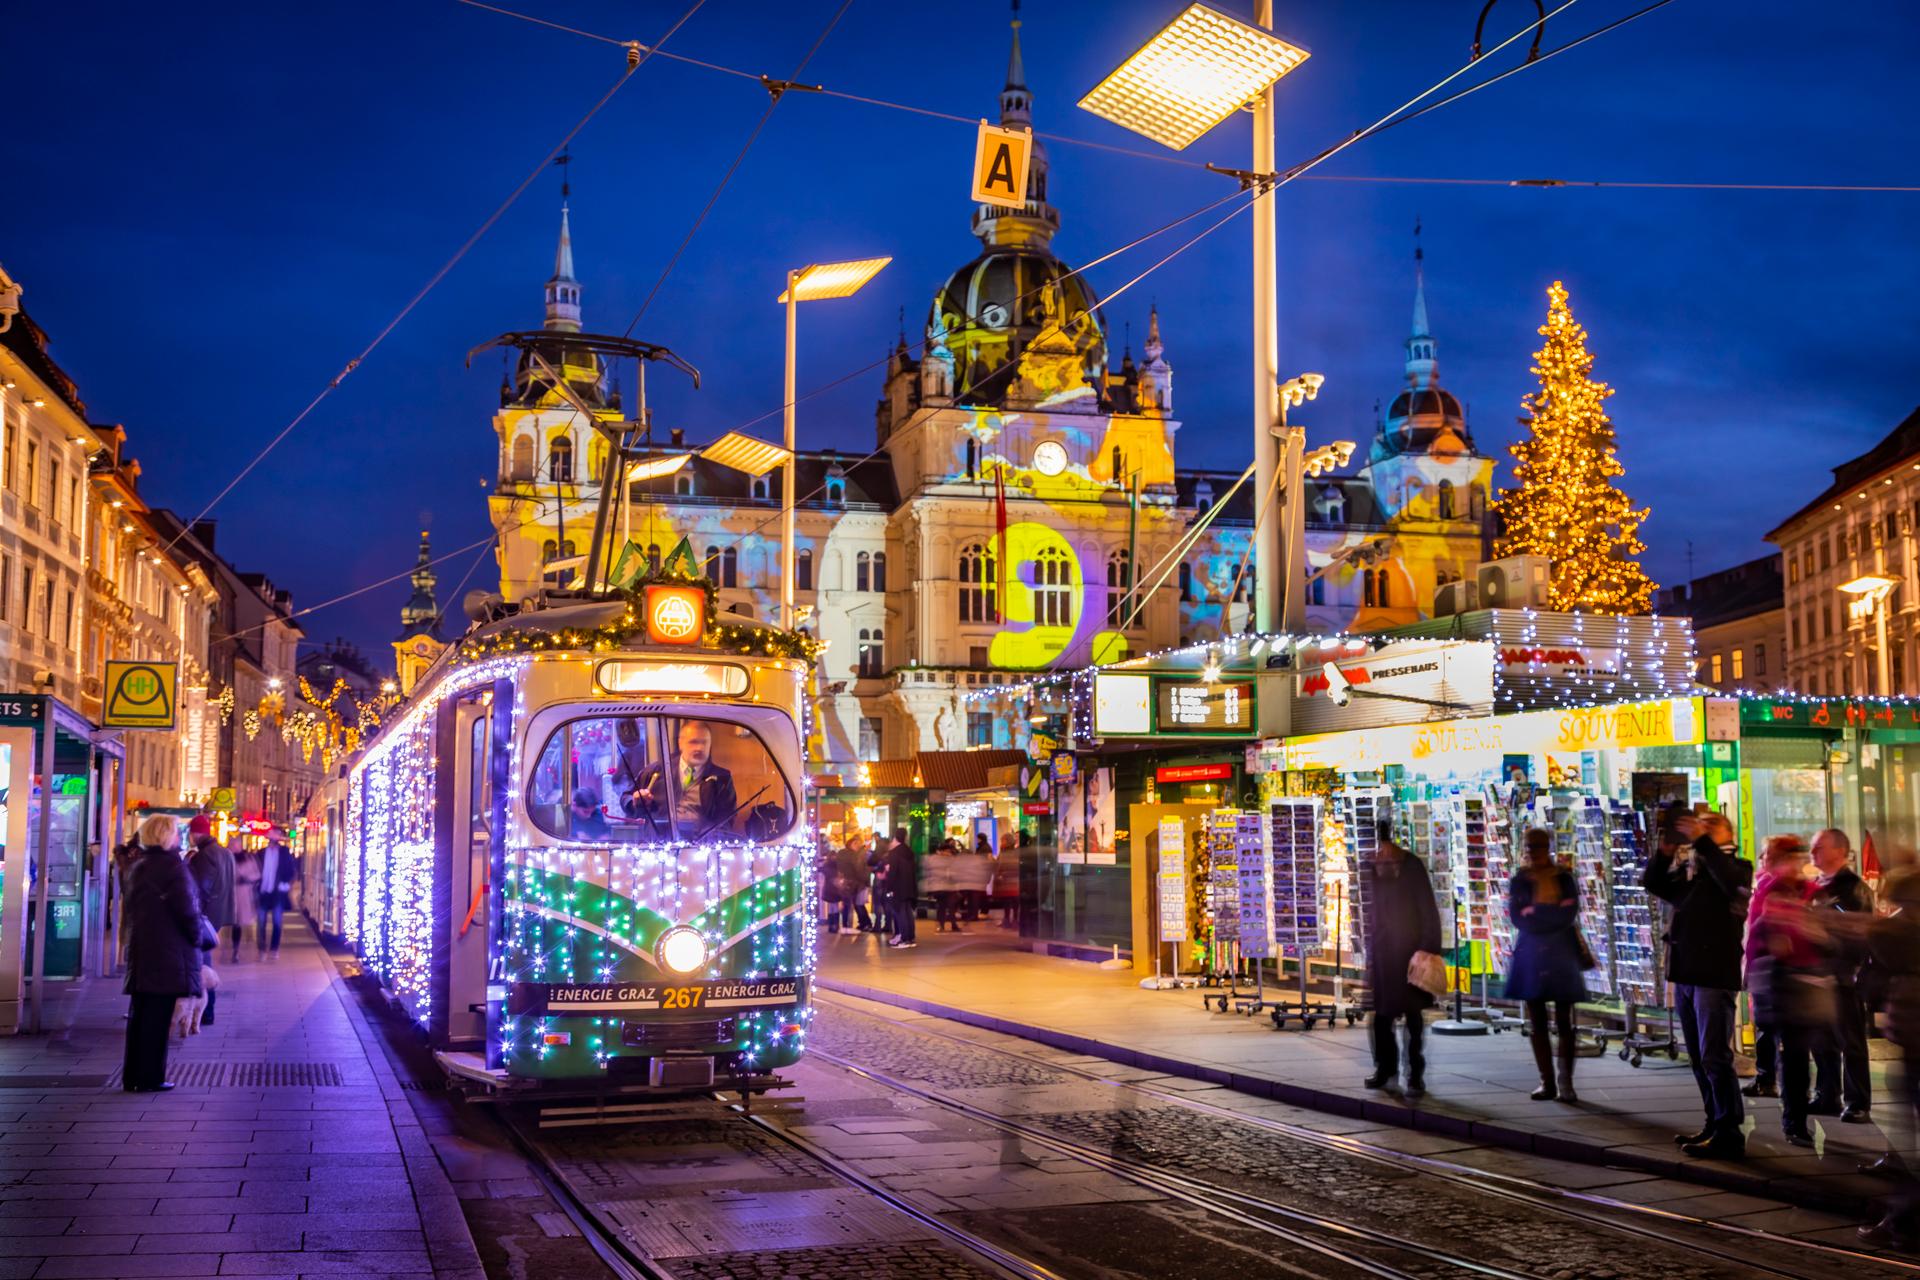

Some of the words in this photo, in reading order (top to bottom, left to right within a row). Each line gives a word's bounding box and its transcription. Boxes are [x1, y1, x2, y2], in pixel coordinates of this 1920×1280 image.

[985, 143, 1015, 193] A
[1371, 661, 1440, 680] PRESSEHAUS
[0, 702, 22, 716] TS
[1772, 706, 1794, 719] WC
[1558, 709, 1666, 744] SOUVENIR
[187, 708, 203, 772] HUMANIC
[203, 719, 218, 778] HUMANIC
[556, 988, 614, 1002] ENERGIE
[618, 987, 656, 1001] GRAZ
[662, 986, 705, 1009] 267
[715, 984, 767, 998] ENERGIE
[769, 982, 797, 996] GRAZ
